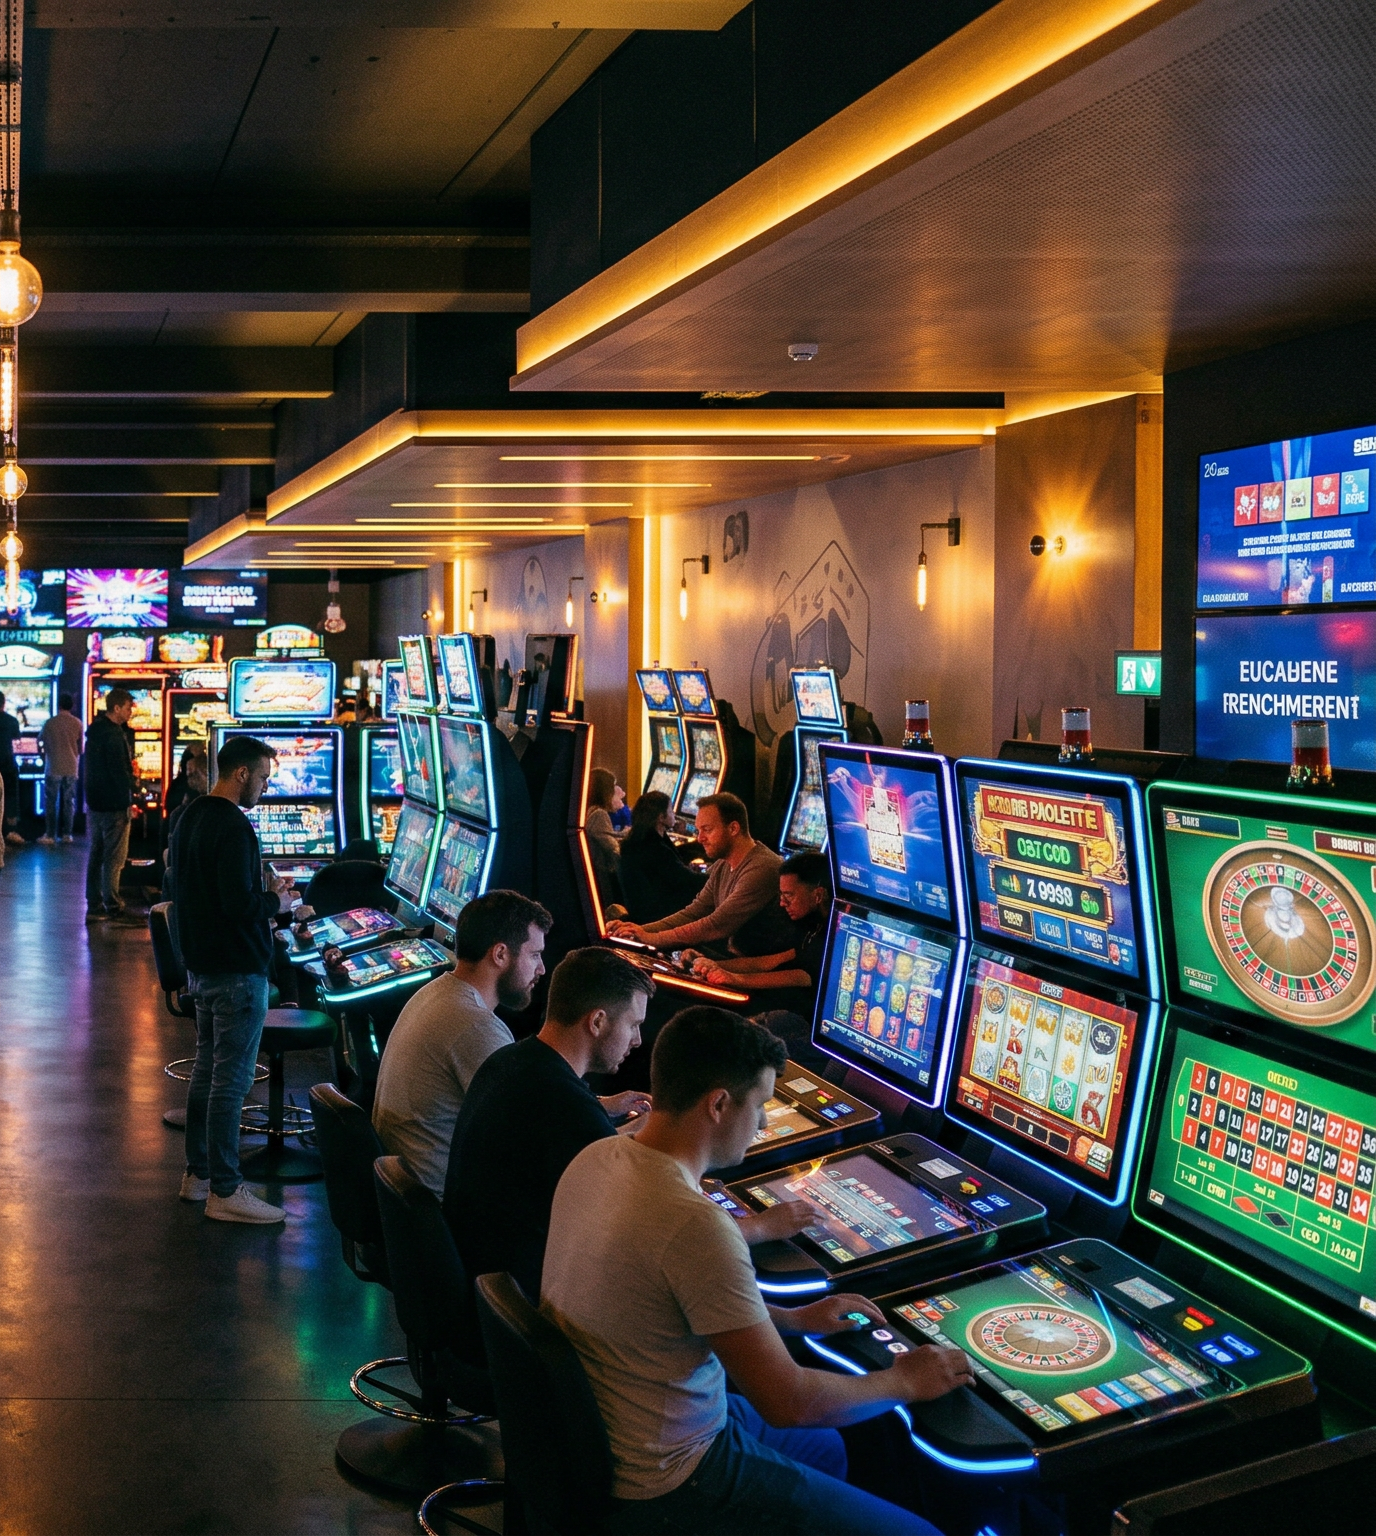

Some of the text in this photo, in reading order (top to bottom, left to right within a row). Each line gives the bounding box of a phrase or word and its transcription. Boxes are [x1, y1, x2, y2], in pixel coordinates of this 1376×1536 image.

[1210, 1076, 1216, 1090] 6
[1224, 1081, 1230, 1094] 9
[1191, 1098, 1197, 1112] 2
[1250, 1092, 1262, 1108] 15
[1280, 1103, 1292, 1120] 21
[1187, 1125, 1192, 1138] 1
[1200, 1131, 1207, 1144] 4
[1260, 1126, 1273, 1141] 17
[1328, 1121, 1342, 1138] 27
[1275, 1132, 1288, 1148] 17
[1240, 1148, 1252, 1164] 13
[1286, 1167, 1299, 1185] 19
[1340, 1158, 1354, 1178] 32
[1358, 1165, 1372, 1184] 35
[1336, 1189, 1348, 1208] 31
[1353, 1196, 1368, 1216] 34
